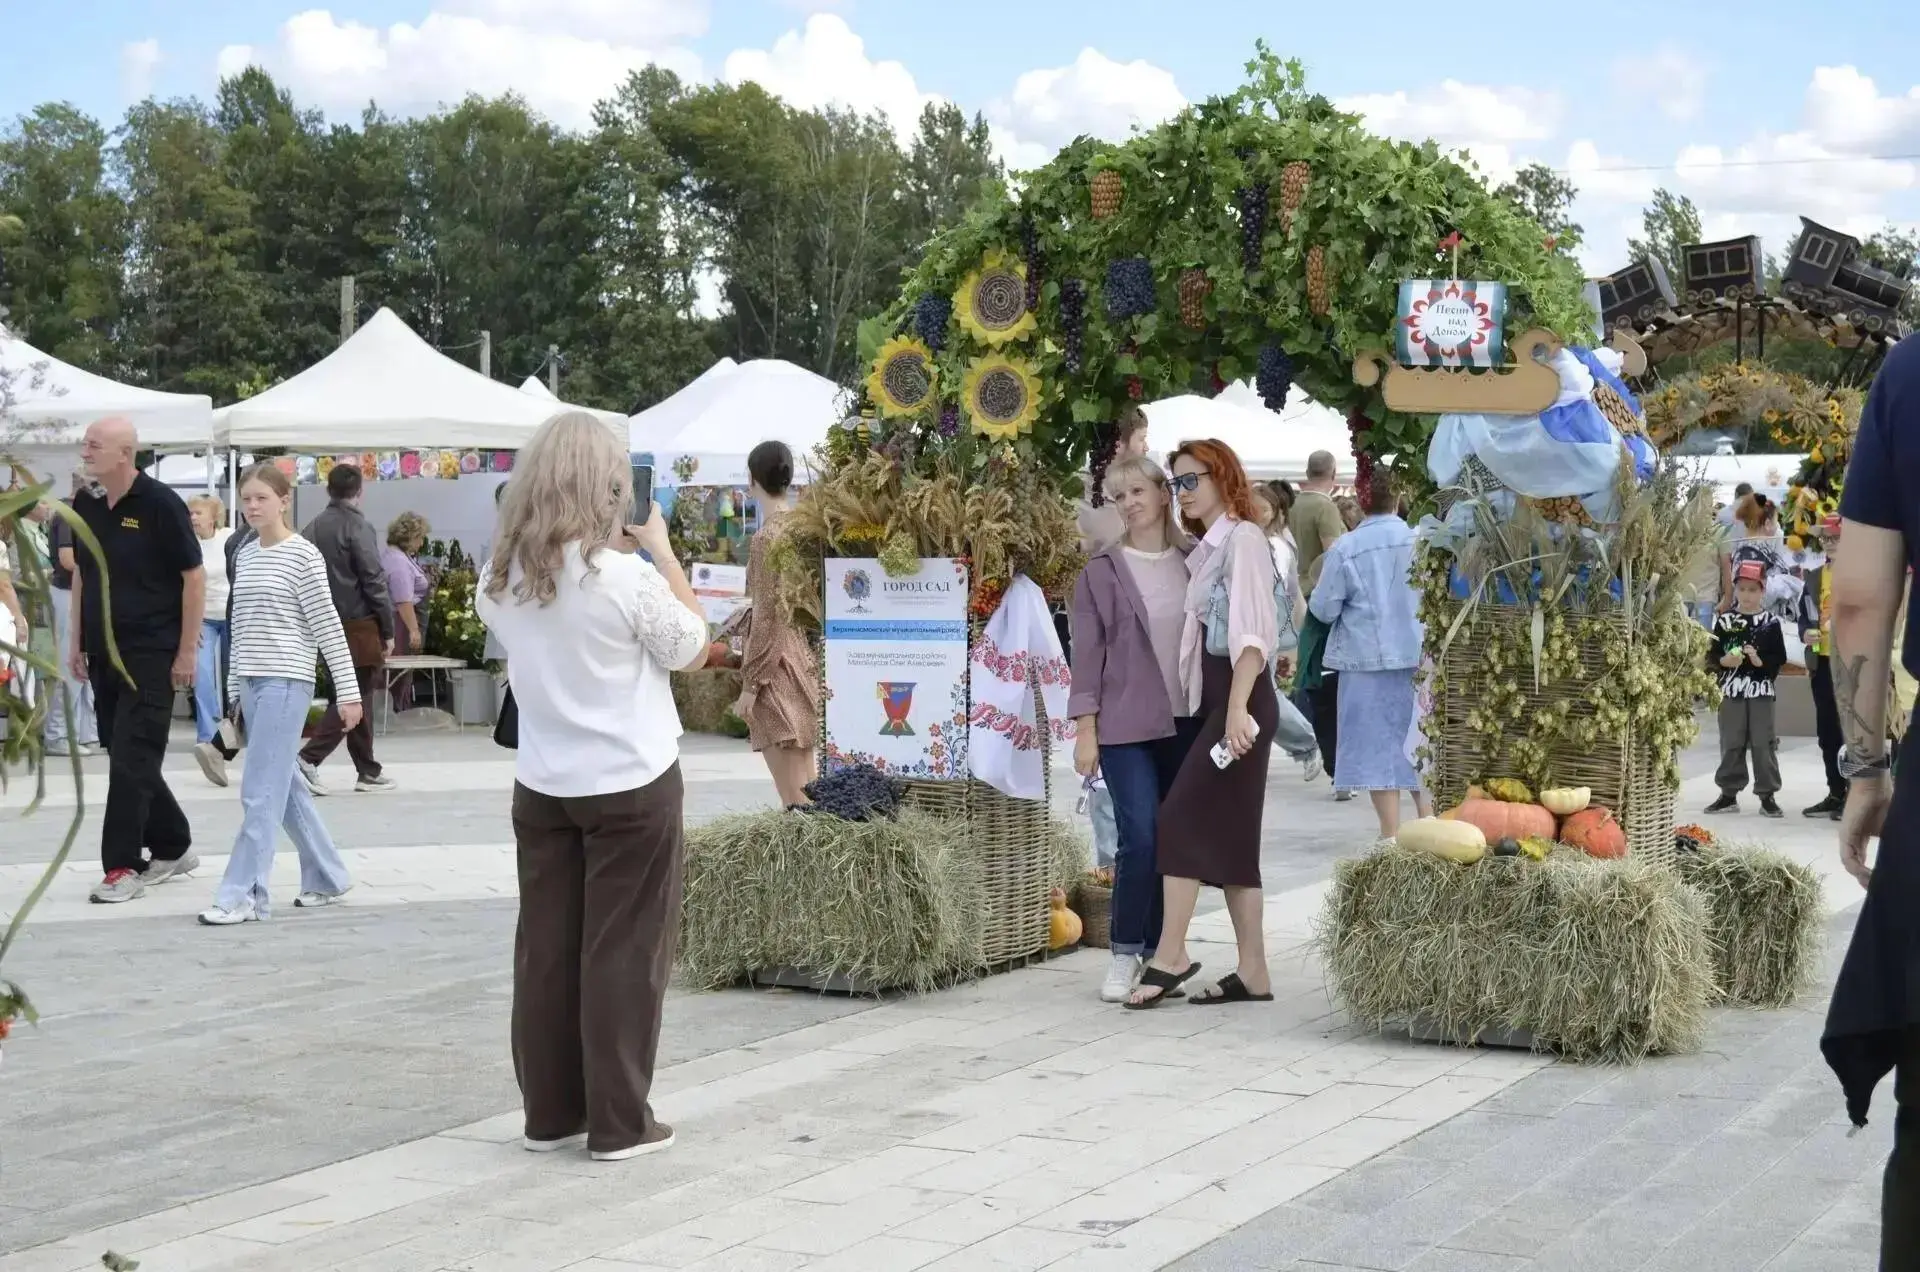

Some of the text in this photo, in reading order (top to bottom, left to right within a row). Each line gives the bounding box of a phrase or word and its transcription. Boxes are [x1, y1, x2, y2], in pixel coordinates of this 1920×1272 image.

[1435, 304, 1469, 314] Песни
[1448, 319, 1468, 328] над
[1431, 326, 1466, 337] Доном
[883, 581, 951, 592] ГОРОД САД
